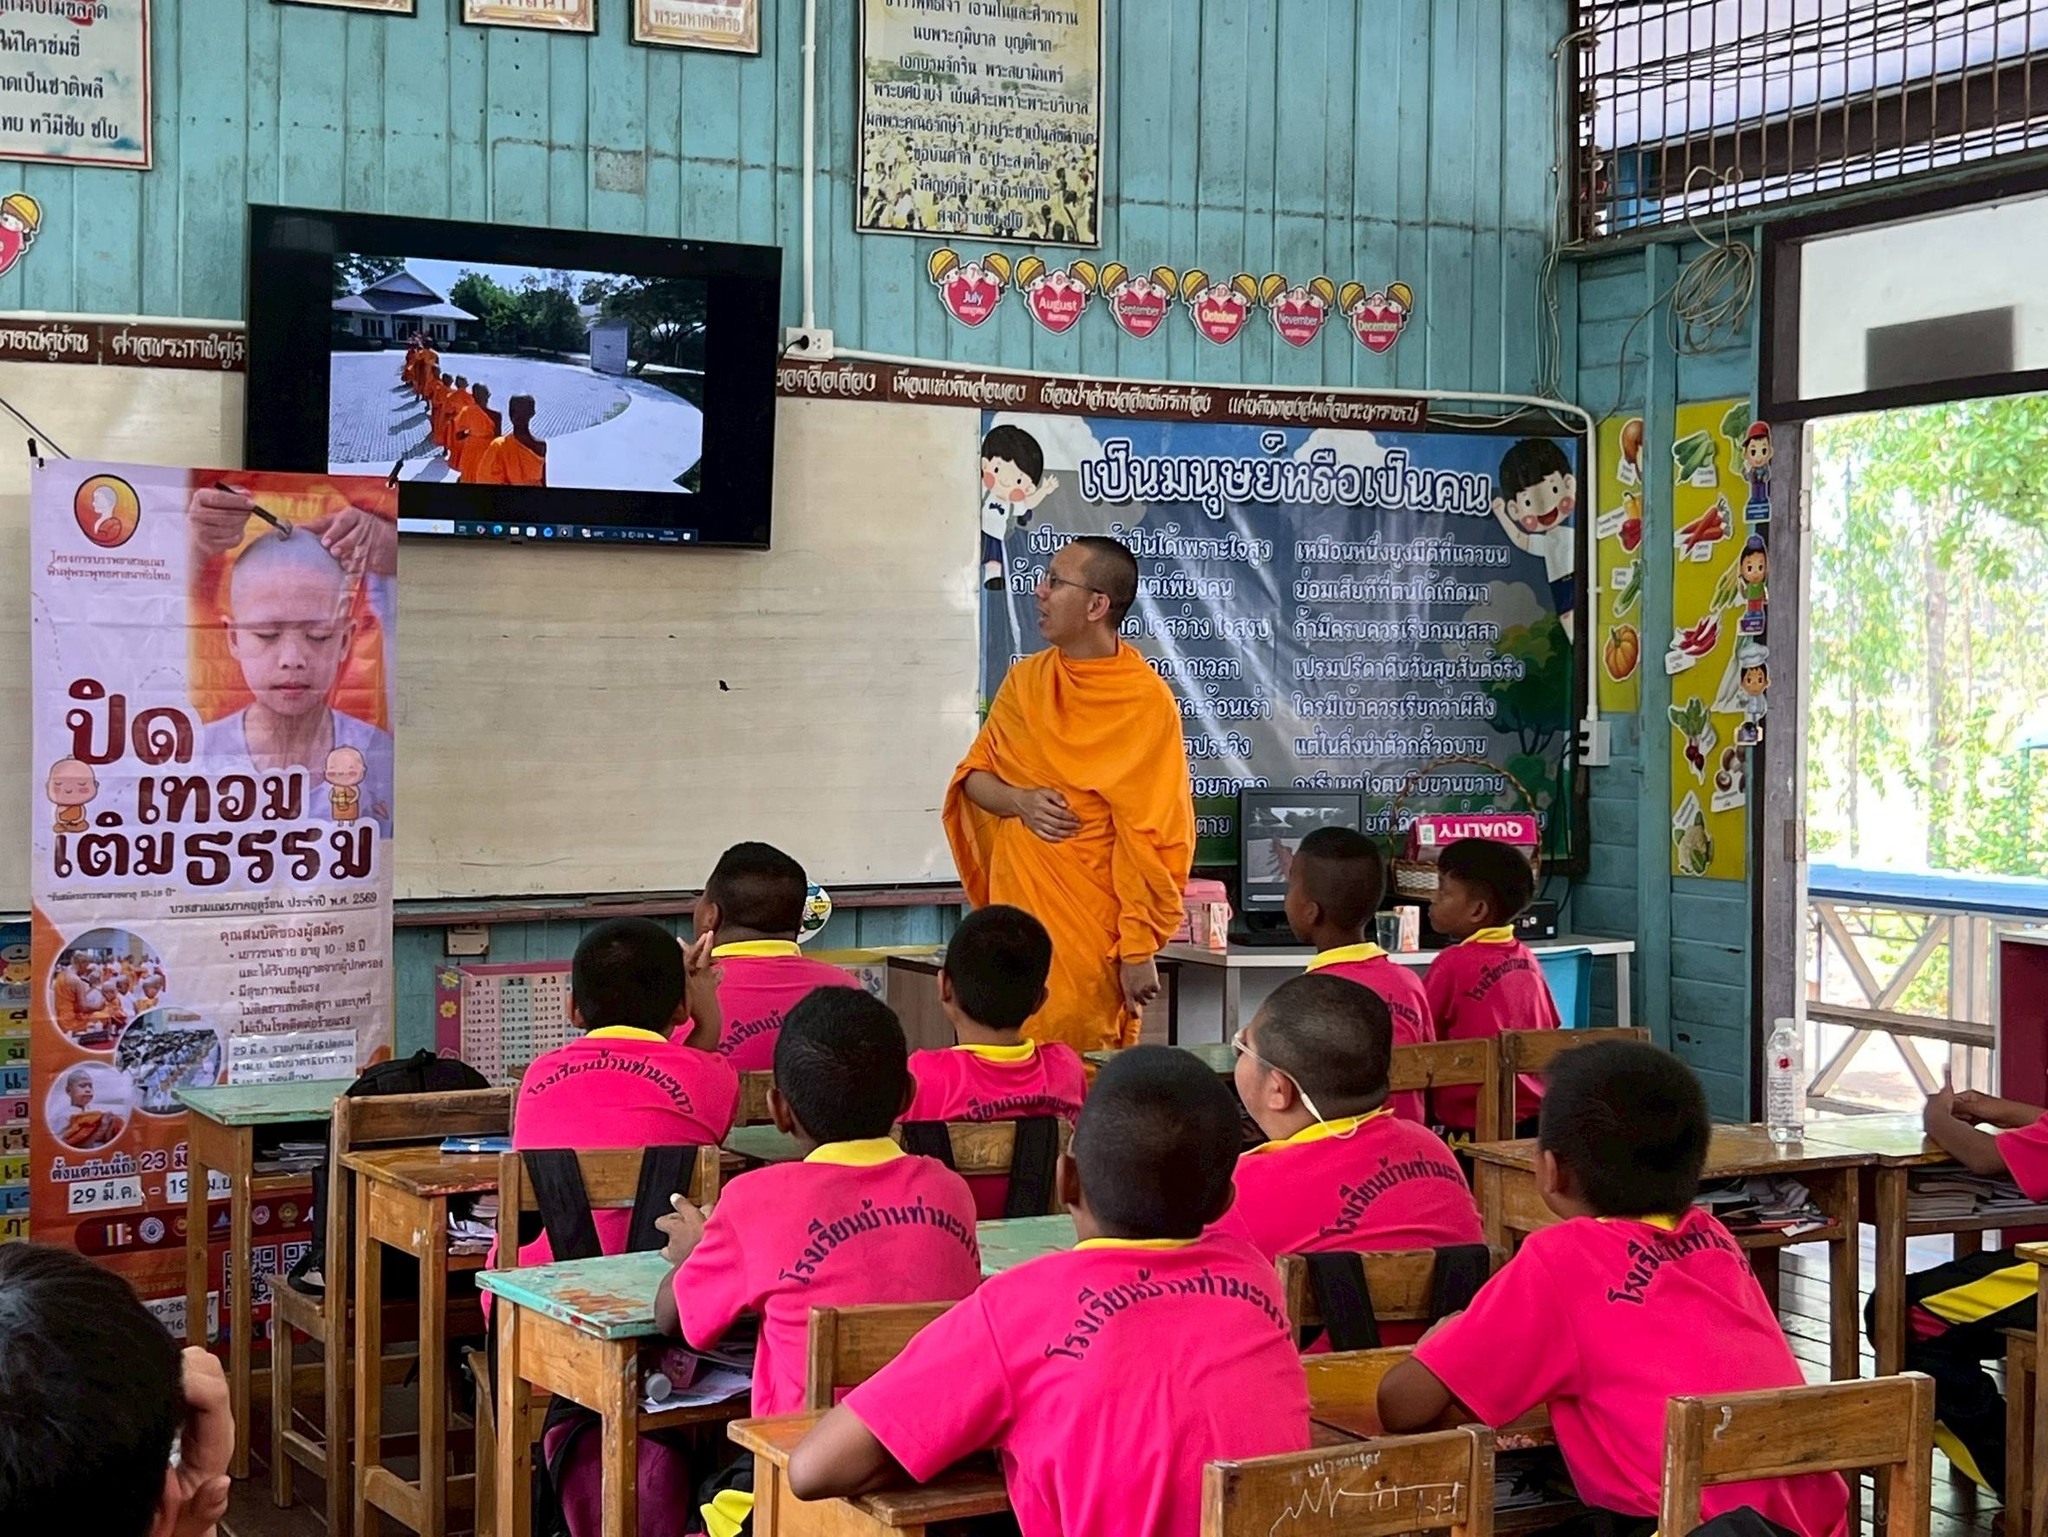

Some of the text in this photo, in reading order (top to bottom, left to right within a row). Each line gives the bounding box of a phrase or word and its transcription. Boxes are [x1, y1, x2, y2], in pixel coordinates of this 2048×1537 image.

[91, 116, 119, 140] ชโย
[962, 291, 984, 305] July
[1038, 296, 1078, 312] August
[1278, 313, 1319, 327] November
[1081, 432, 1490, 517] เป็นมนุษย์หรือเป็นคน
[66, 677, 195, 766] ปิด
[137, 771, 303, 824] เทอม
[1438, 820, 1524, 840] QUALITY
[352, 891, 377, 904] 2569
[526, 1048, 696, 1116] โรงเรียนบ้านท่ามะนาว
[141, 1152, 167, 1171] 23
[72, 1186, 96, 1206] 29
[102, 1181, 138, 1203] มี.ค.
